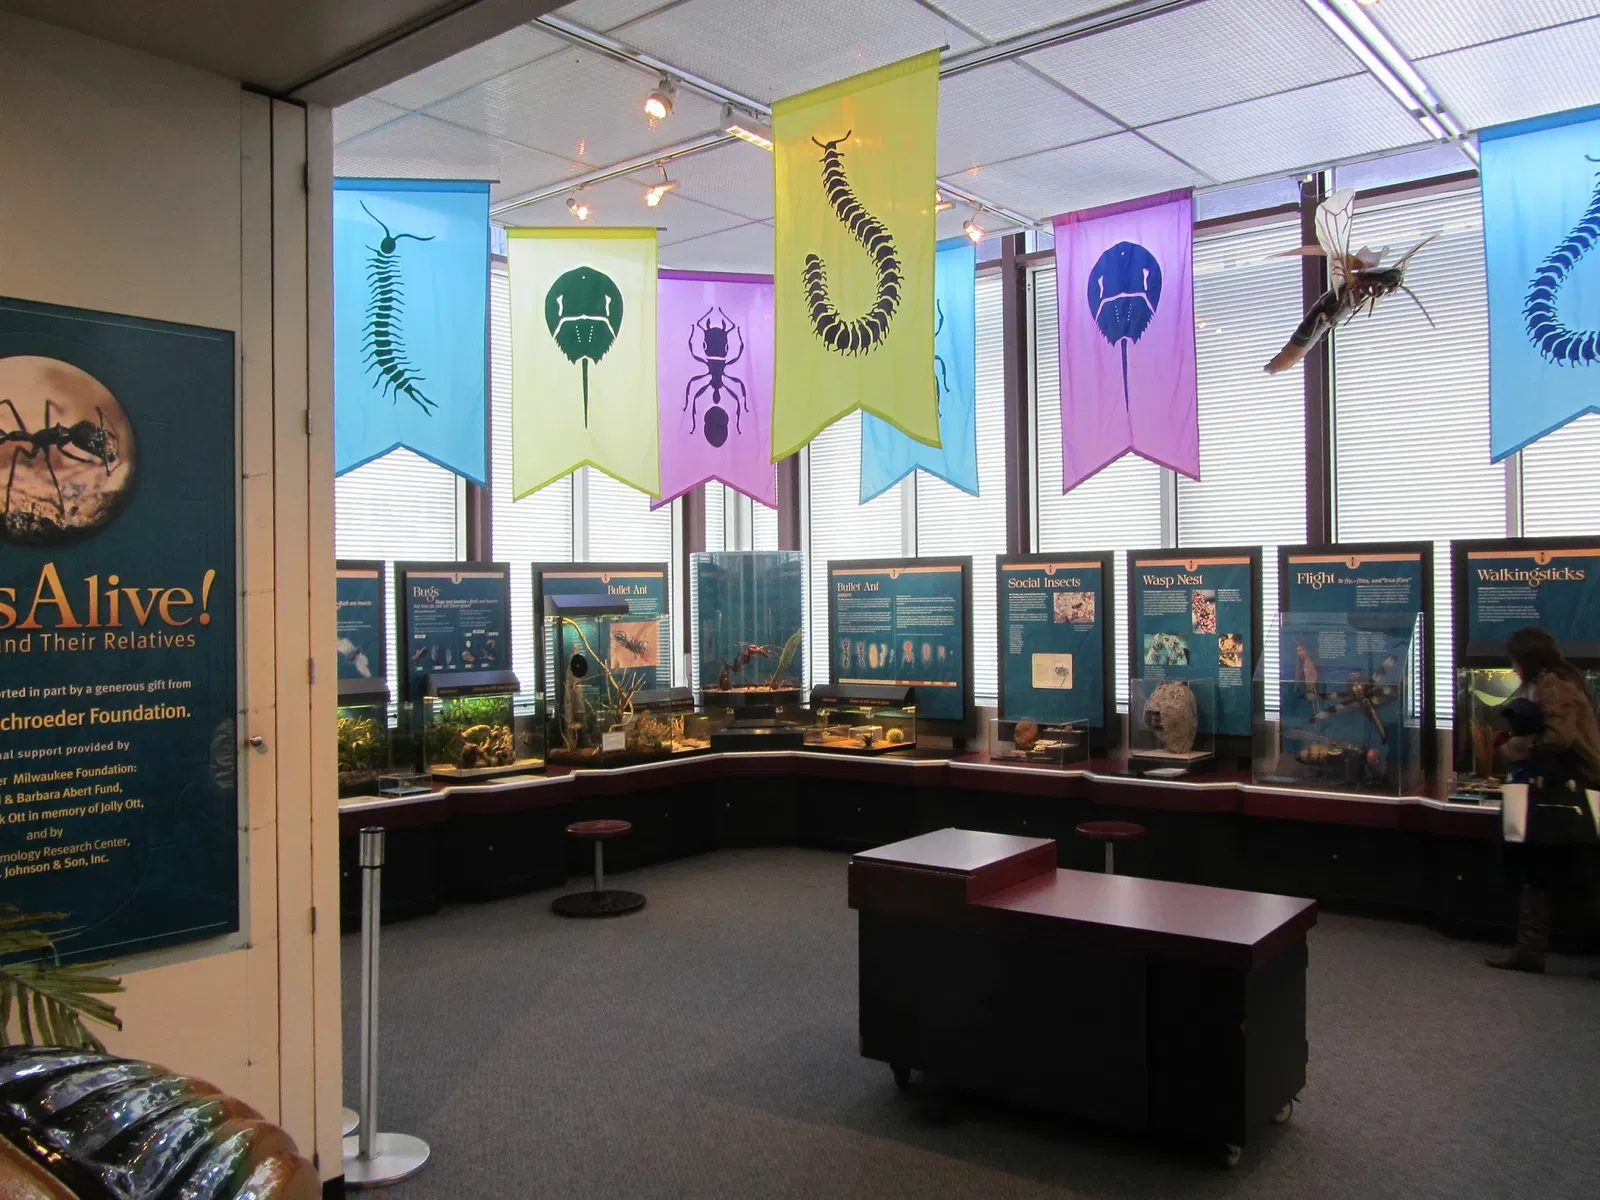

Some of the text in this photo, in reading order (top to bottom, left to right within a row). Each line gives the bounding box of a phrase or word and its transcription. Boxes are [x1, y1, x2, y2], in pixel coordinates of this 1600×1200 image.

[837, 581, 879, 592] Bullet Ant
[1008, 577, 1081, 589] Social Insects
[1143, 574, 1203, 588] Wasp Nest
[1297, 571, 1335, 590] Flight
[1477, 567, 1585, 587] Walkingsticks
[412, 586, 440, 602] Bugs
[607, 584, 648, 595] Bullet Ant
[0, 631, 196, 653] nd Their Relatives
[29, 686, 40, 697] in
[43, 686, 67, 699] part
[69, 684, 84, 697] by
[85, 686, 92, 694] a
[95, 683, 145, 696] generous
[147, 680, 166, 693] gift
[168, 679, 191, 689] from
[90, 703, 191, 724] Foundation.
[17, 746, 62, 759] support
[66, 741, 114, 756] provided
[117, 740, 130, 752] by
[13, 770, 74, 784] Milwaukee
[76, 764, 137, 778] Foundation:
[4, 794, 13, 804] &
[17, 789, 60, 803] Barbara
[63, 786, 92, 798] Abert
[94, 782, 123, 795] Fund,
[8, 812, 26, 823] Ott
[28, 810, 39, 821] in
[41, 806, 86, 820] memory
[88, 803, 101, 814] of
[100, 800, 123, 813] Jolly
[125, 798, 144, 810] Ott,
[26, 826, 64, 840] and by
[43, 841, 92, 857] Research
[94, 837, 130, 849] Center,
[4, 862, 50, 878] Johnson
[52, 860, 61, 870] &
[64, 857, 88, 868] Son,
[91, 853, 109, 864] Inc.
